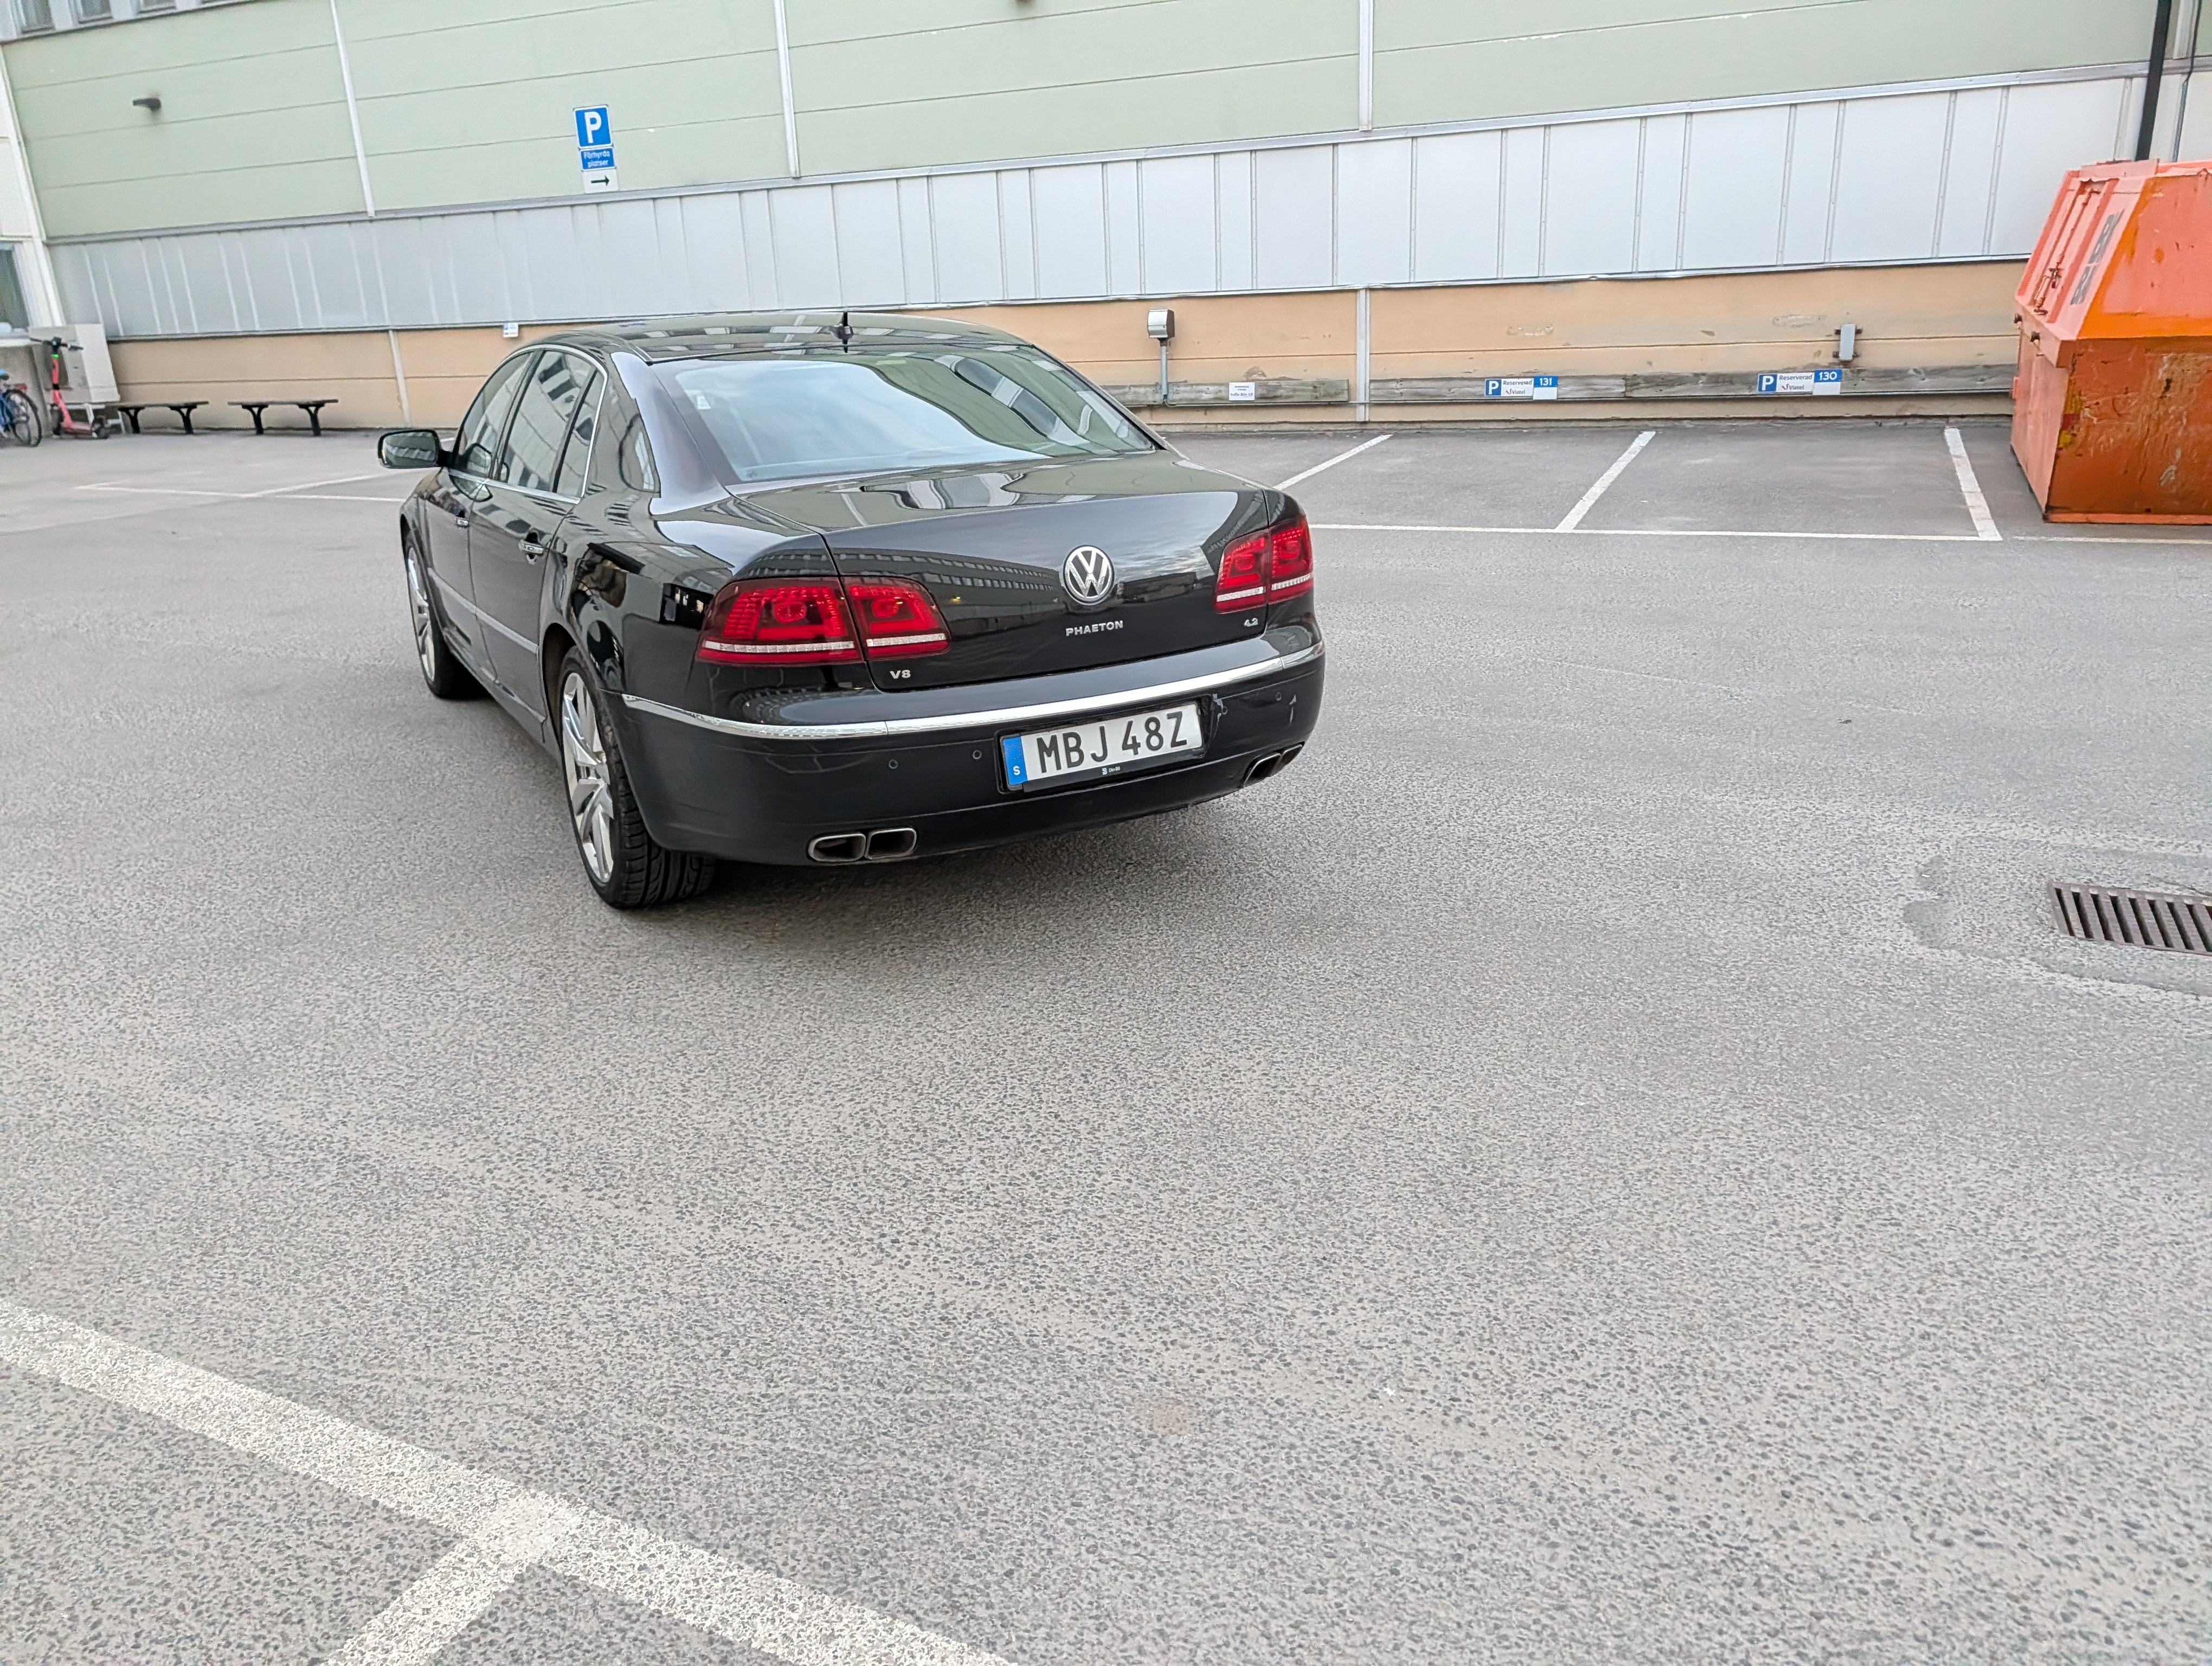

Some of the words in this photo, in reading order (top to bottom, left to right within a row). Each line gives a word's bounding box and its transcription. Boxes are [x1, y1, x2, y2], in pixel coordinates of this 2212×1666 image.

[584, 111, 602, 144] P
[1539, 377, 1552, 386] 131
[1819, 371, 1837, 381] 130
[1488, 381, 1499, 395] P
[1762, 375, 1774, 391] P
[1065, 619, 1124, 637] PHAETON
[1243, 617, 1259, 627] 4.2
[889, 669, 911, 680] V8
[1036, 725, 1108, 774] MBJ
[1122, 710, 1188, 756] 48Z
[1013, 765, 1021, 776] S
